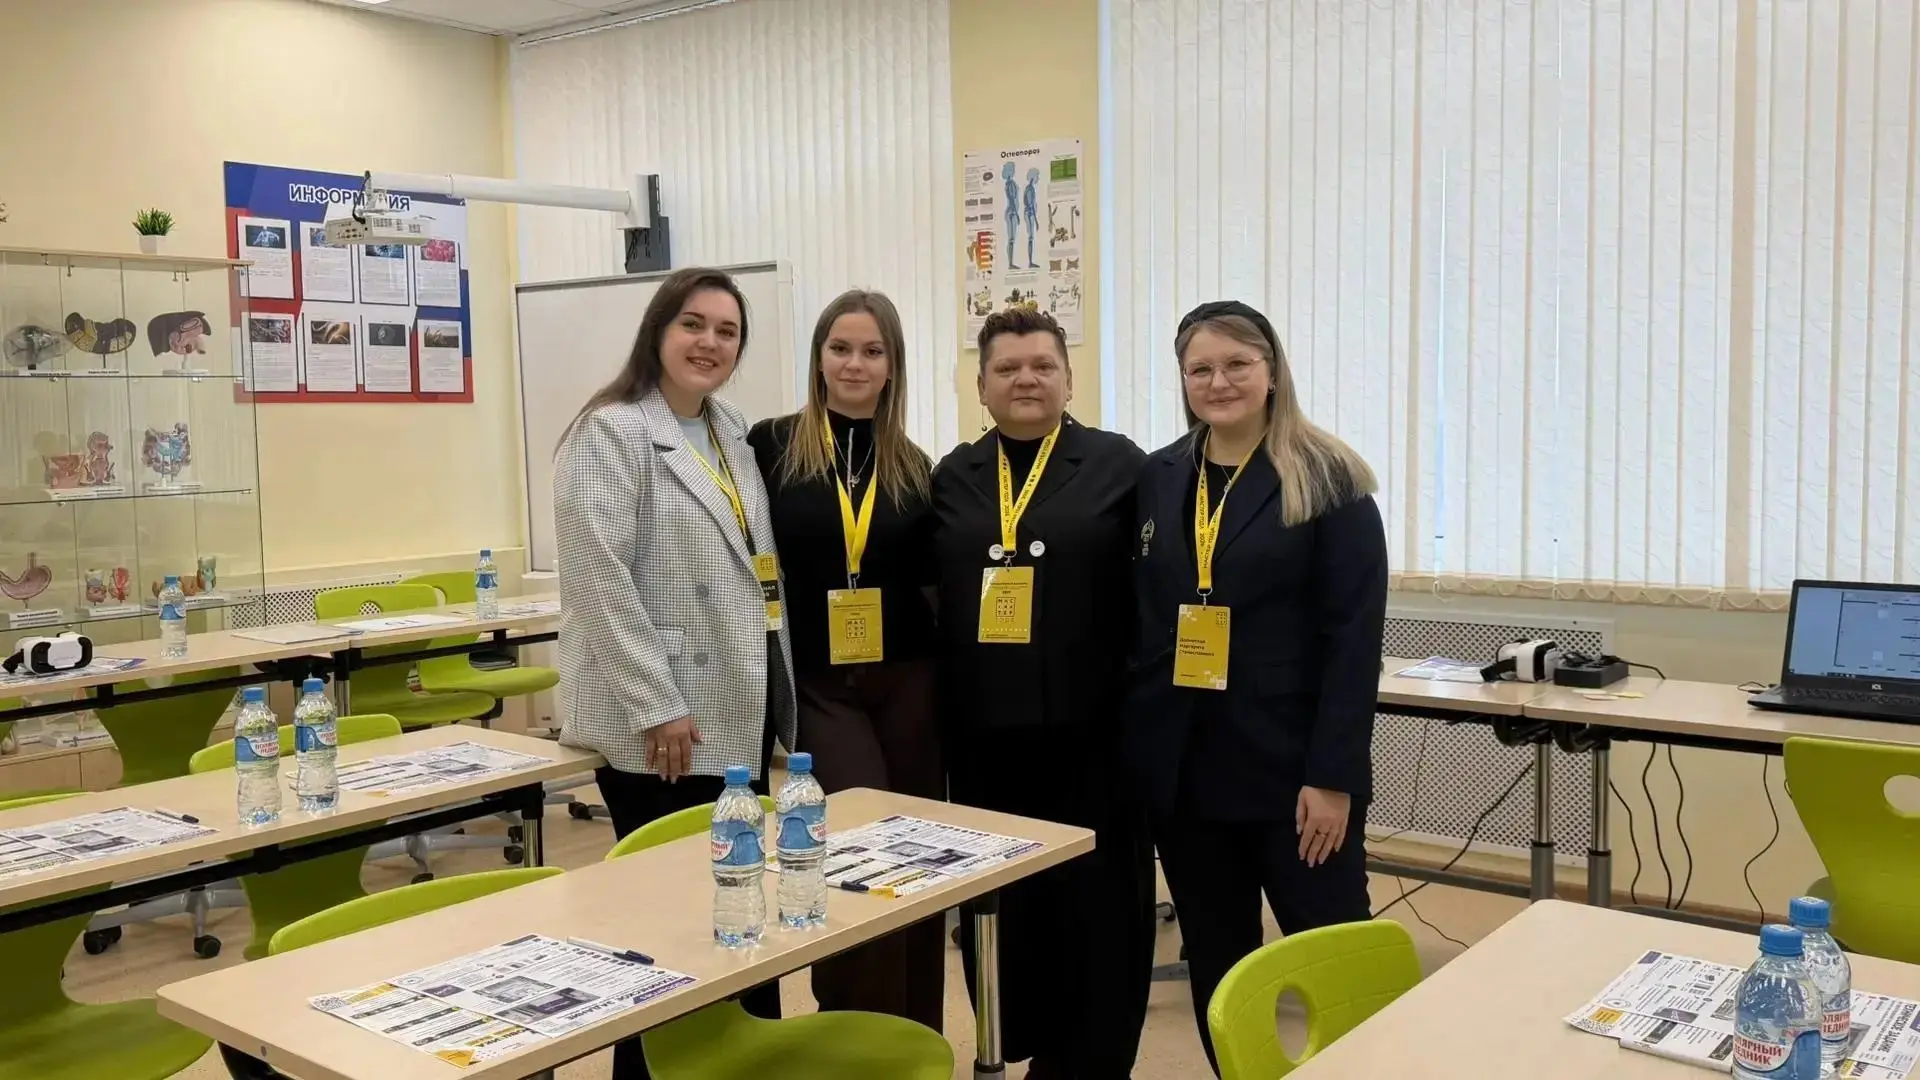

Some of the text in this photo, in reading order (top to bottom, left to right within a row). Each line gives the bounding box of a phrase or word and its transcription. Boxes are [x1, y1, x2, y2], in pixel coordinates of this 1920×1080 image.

[288, 183, 411, 211] ИНФОРМИЯ
[1735, 1036, 1782, 1057] ОЛЯРНЫЙ
[1735, 1043, 1772, 1066] ЕДНИК
